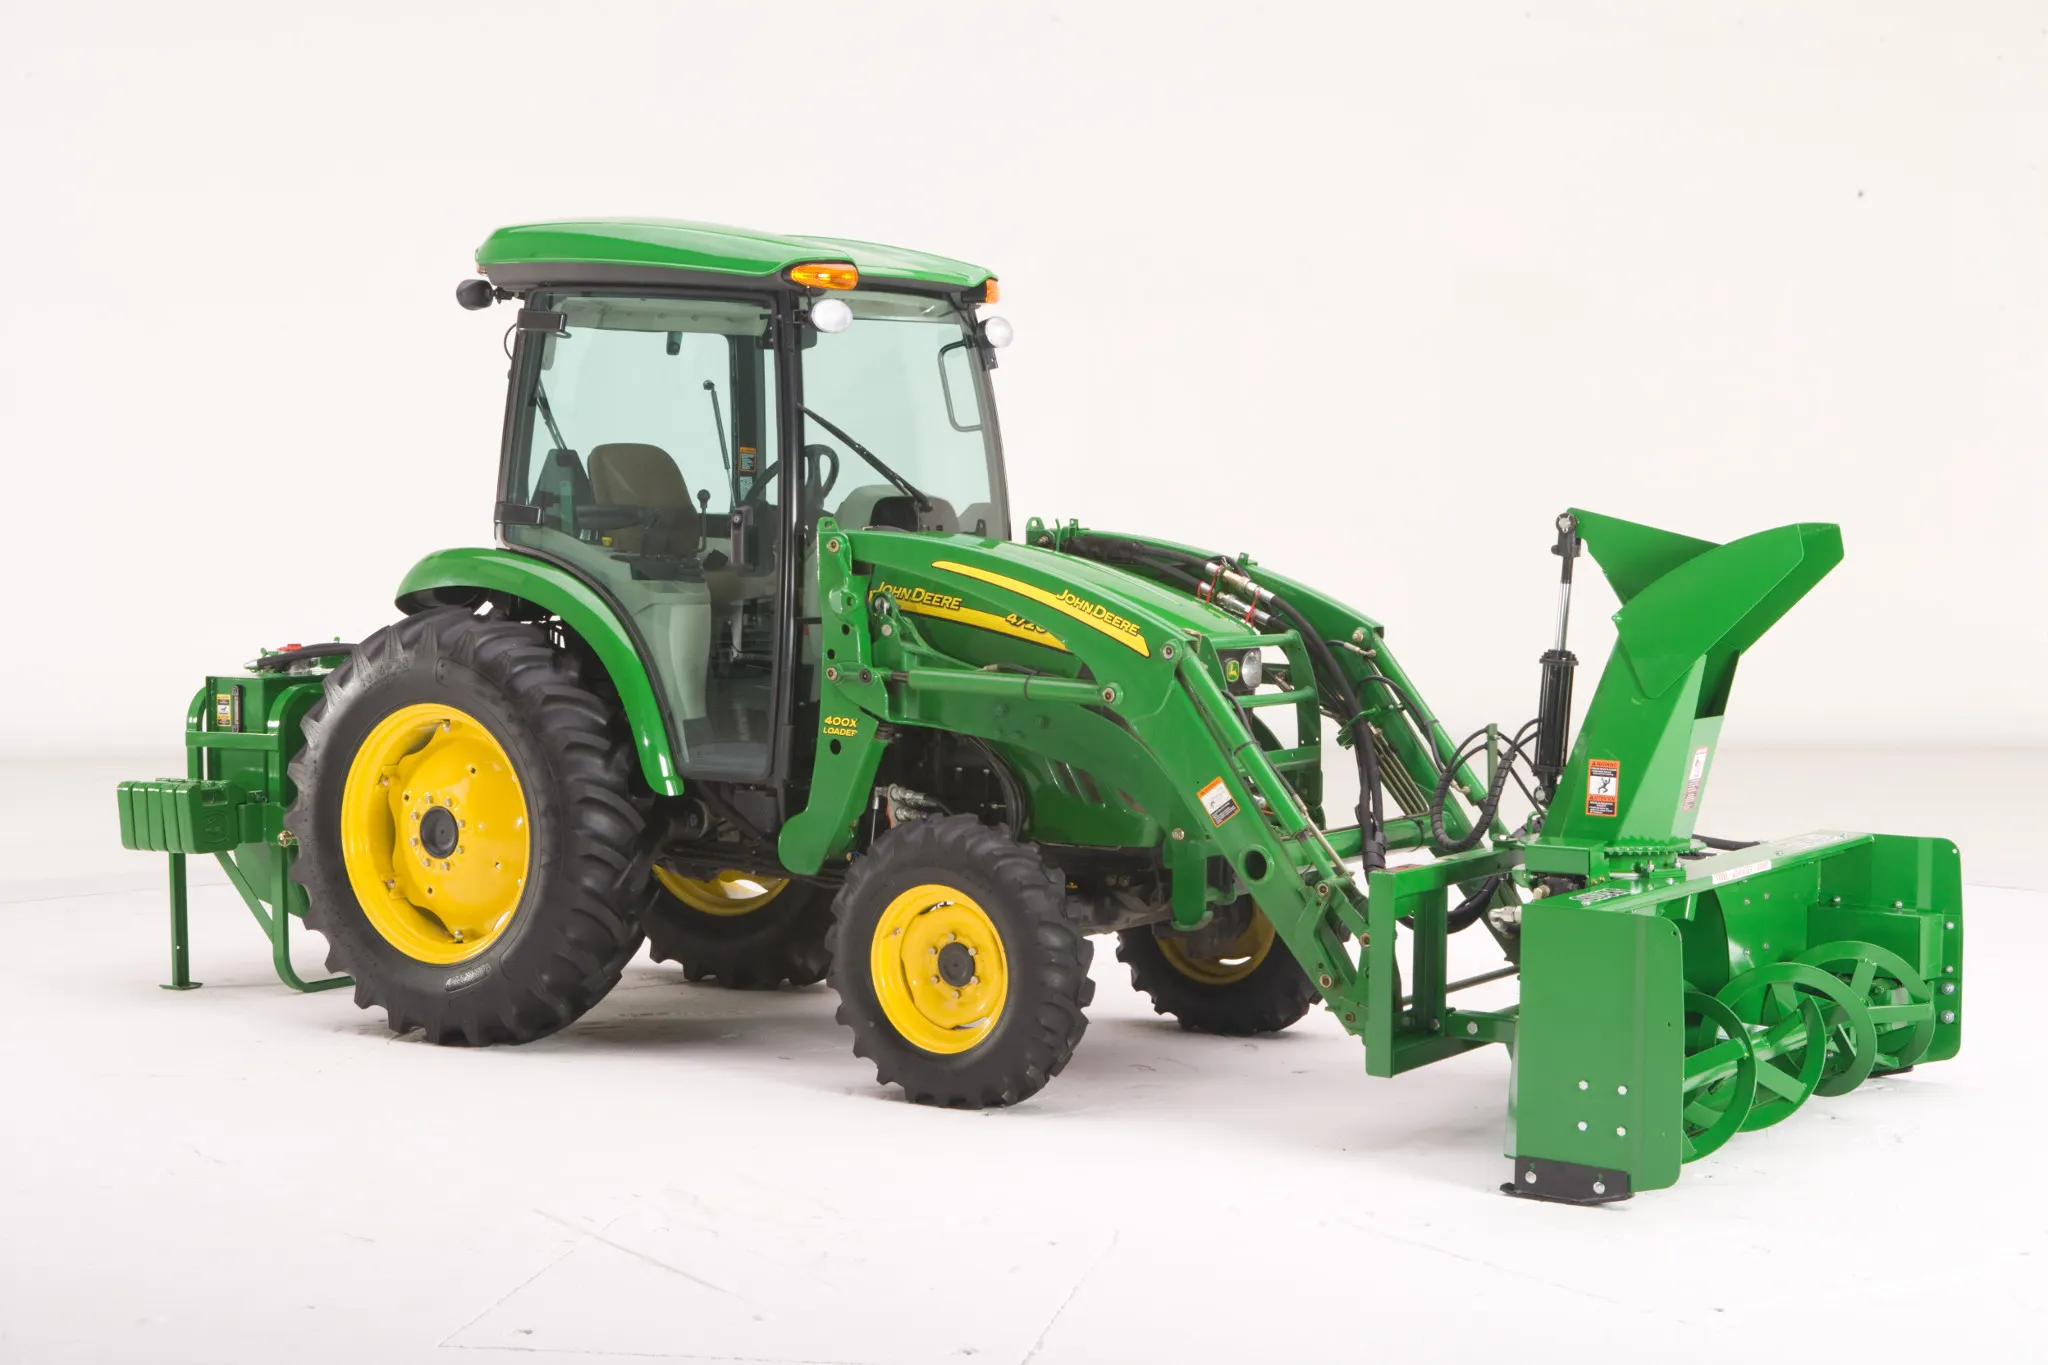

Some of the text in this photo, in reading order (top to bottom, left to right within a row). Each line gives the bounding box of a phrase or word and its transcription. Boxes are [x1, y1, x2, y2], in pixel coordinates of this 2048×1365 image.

[910, 587, 963, 610] DEERE
[1056, 589, 1141, 636] JOHN DEERE
[824, 716, 859, 728] 400X
